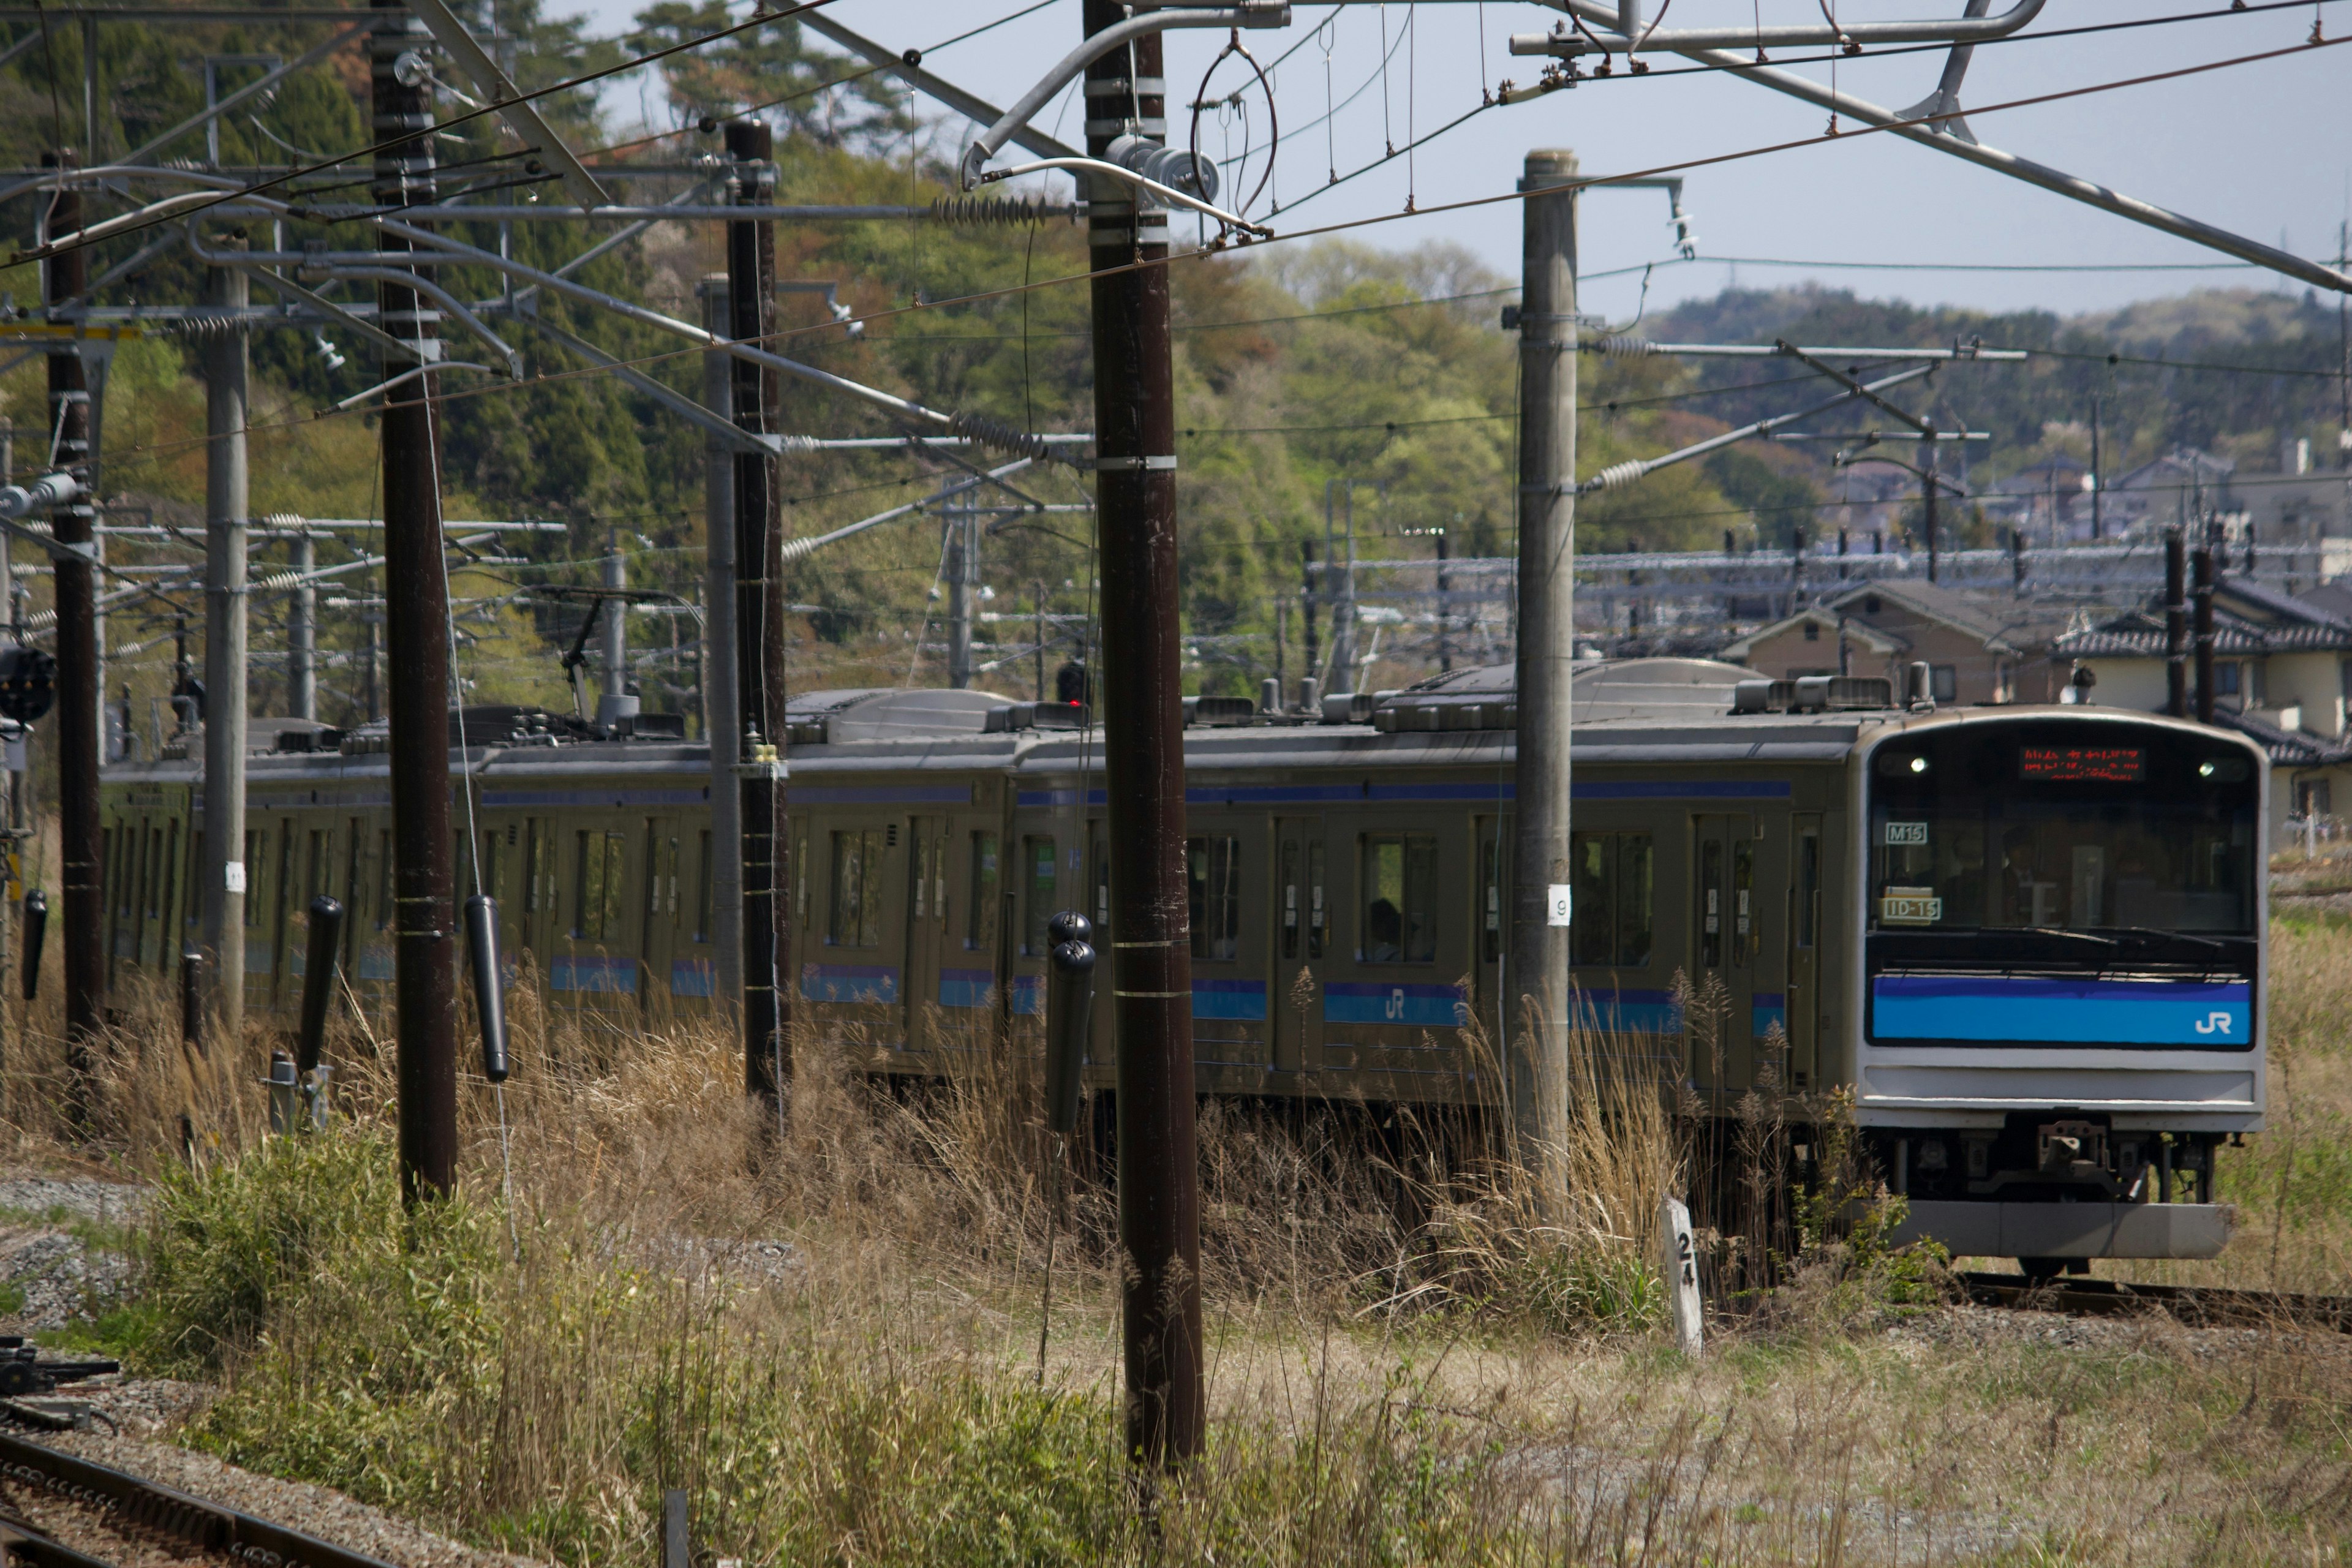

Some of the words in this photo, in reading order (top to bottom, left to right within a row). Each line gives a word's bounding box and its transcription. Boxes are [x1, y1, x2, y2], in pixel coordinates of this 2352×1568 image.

[1890, 827, 1923, 840] M15
[1558, 900, 1566, 916] 9
[1891, 901, 1937, 917] ID-15
[1385, 988, 1404, 1019] JR
[2195, 1011, 2232, 1035] JR
